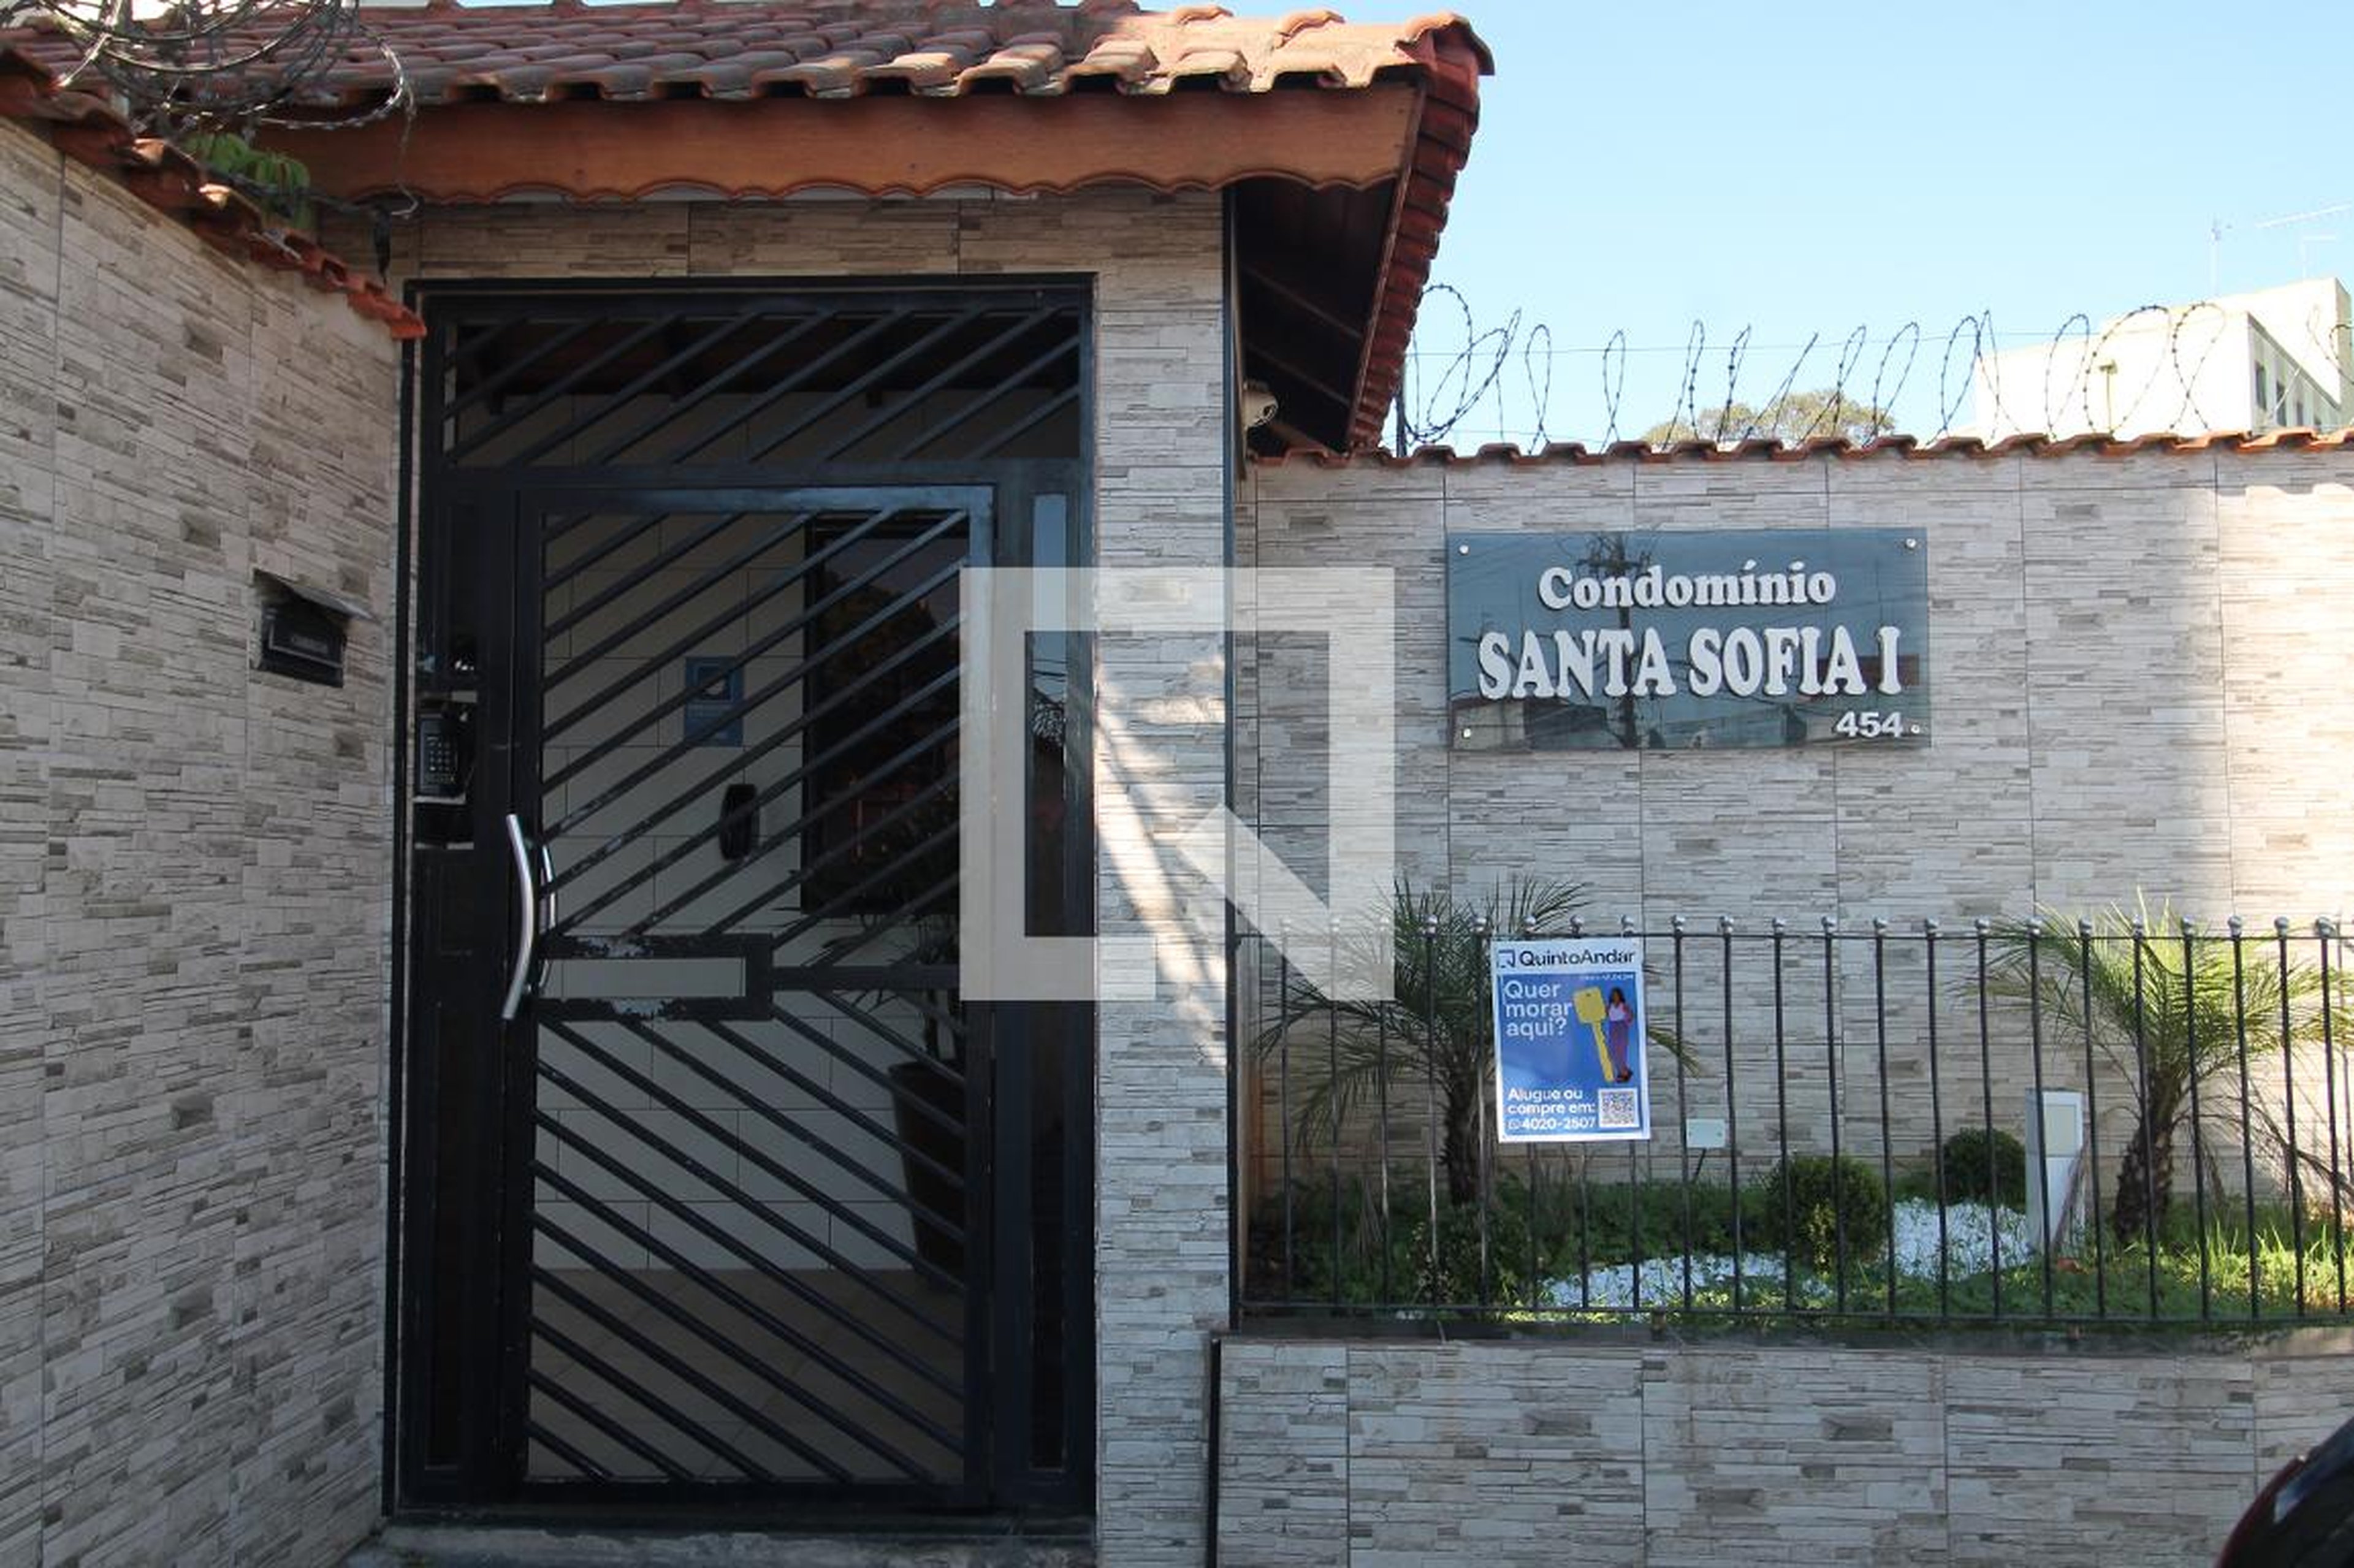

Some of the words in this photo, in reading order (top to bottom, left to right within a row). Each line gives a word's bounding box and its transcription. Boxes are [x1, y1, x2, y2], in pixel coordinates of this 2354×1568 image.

[1539, 560, 1836, 609] Condomínio
[1479, 626, 1675, 699] SANTA
[1688, 625, 1867, 696] SOFIA
[1837, 711, 1903, 737] 454
[1519, 949, 1635, 967] QuintoAndar
[1504, 980, 1561, 999] Quer
[1506, 1002, 1572, 1018] morar
[1506, 1018, 1567, 1041] aqui?
[1507, 1088, 1561, 1103] Alugue
[1563, 1090, 1583, 1100] ou
[1507, 1103, 1565, 1117] compre
